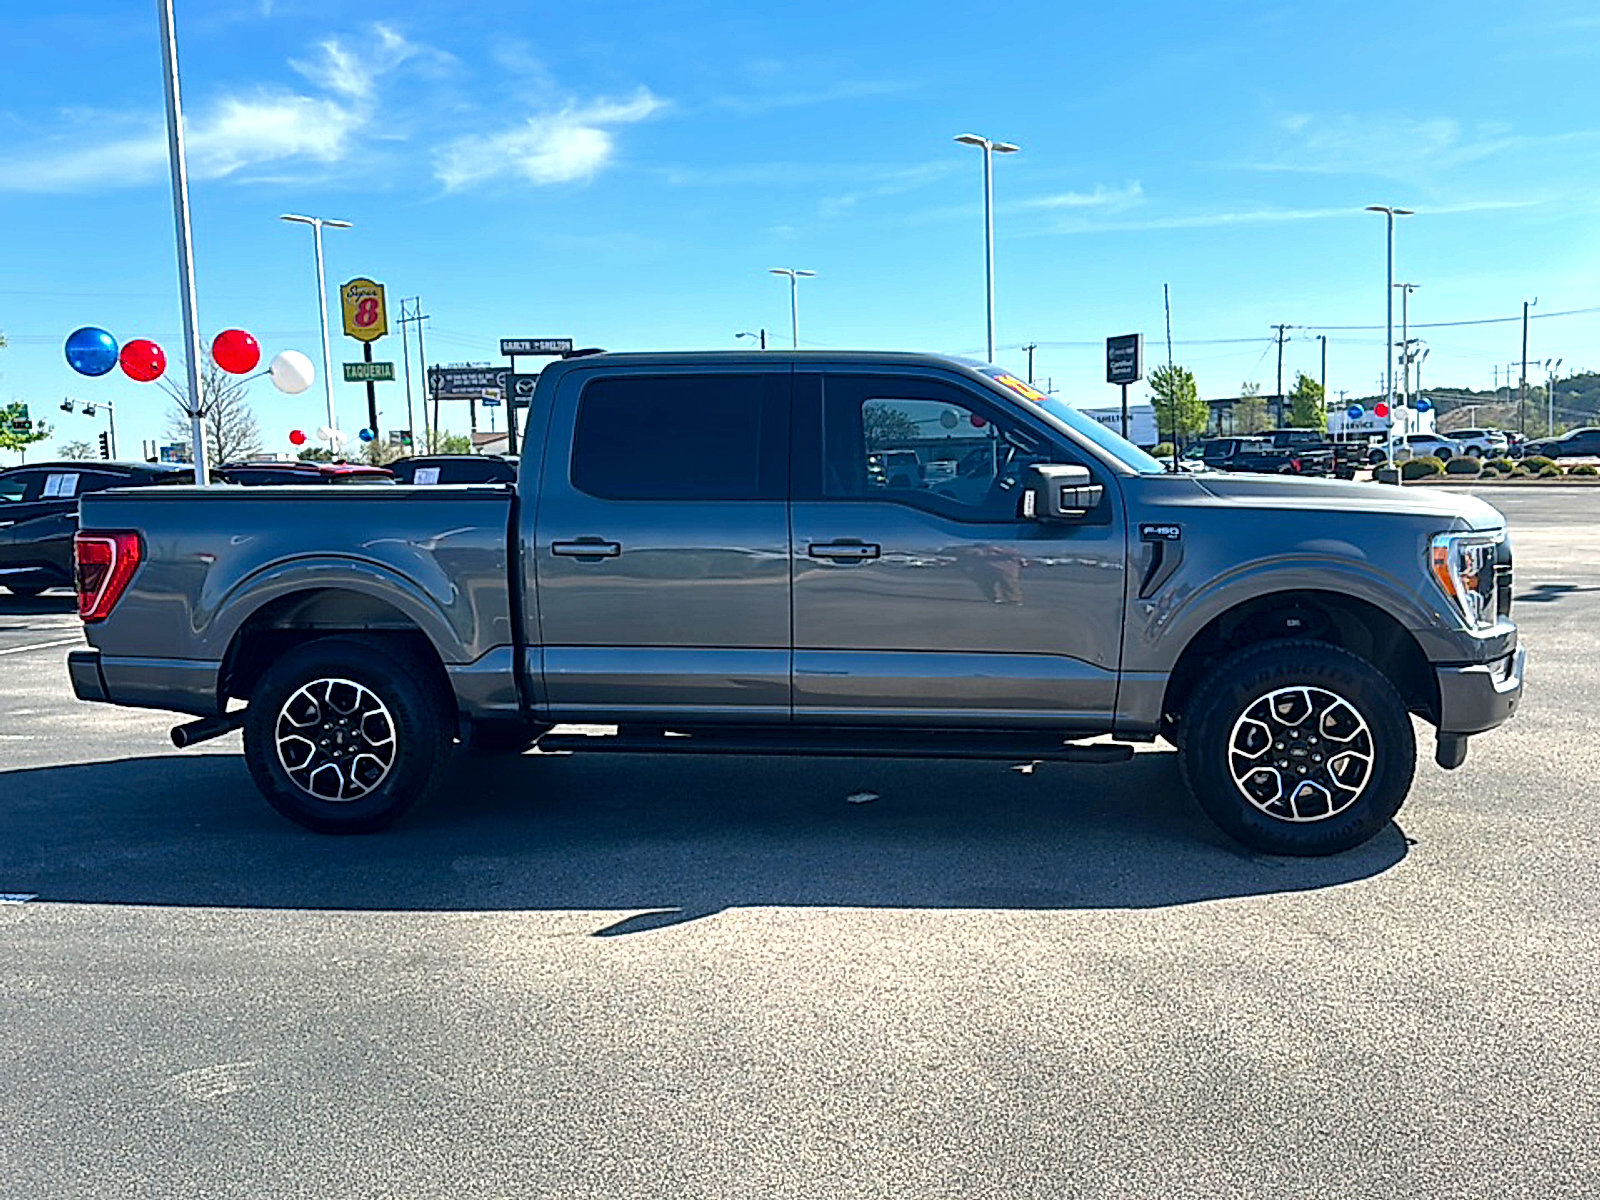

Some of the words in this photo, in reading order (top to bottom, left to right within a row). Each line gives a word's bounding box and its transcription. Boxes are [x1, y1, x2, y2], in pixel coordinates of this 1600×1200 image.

[354, 298, 378, 328] 8
[345, 364, 392, 379] TAQUERIA
[1143, 526, 1180, 535] F-150
